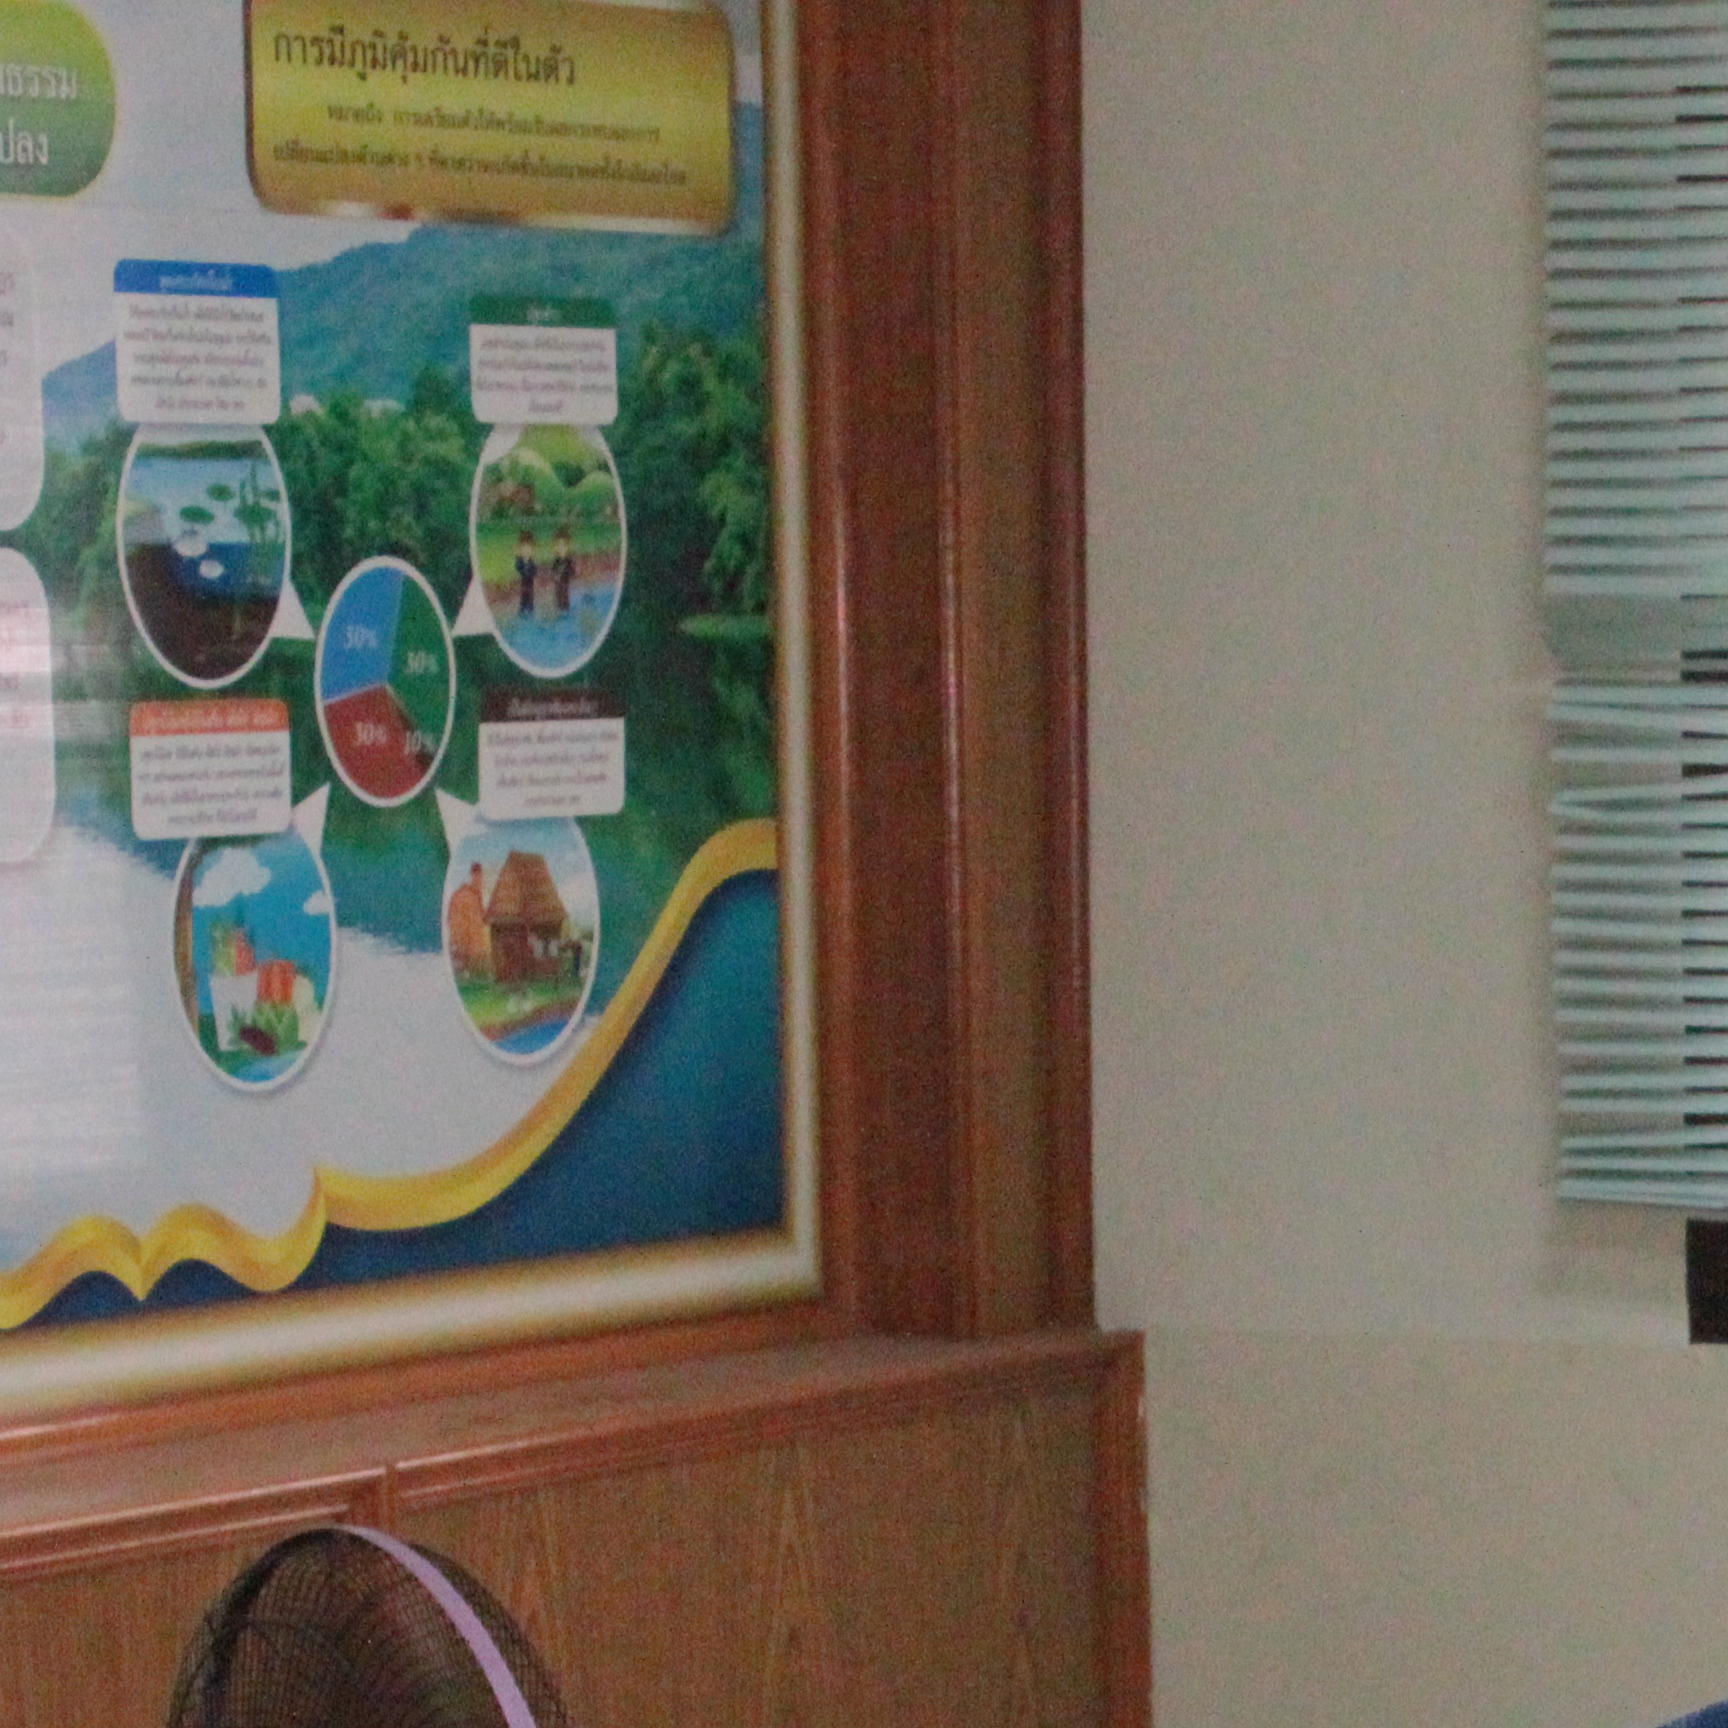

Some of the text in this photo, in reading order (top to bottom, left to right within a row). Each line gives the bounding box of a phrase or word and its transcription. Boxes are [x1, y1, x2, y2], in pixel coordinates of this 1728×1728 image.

[274, 24, 575, 85] การมีภูมิคุ้มกันที่ดีในตัว
[0, 63, 77, 99] ธรรม
